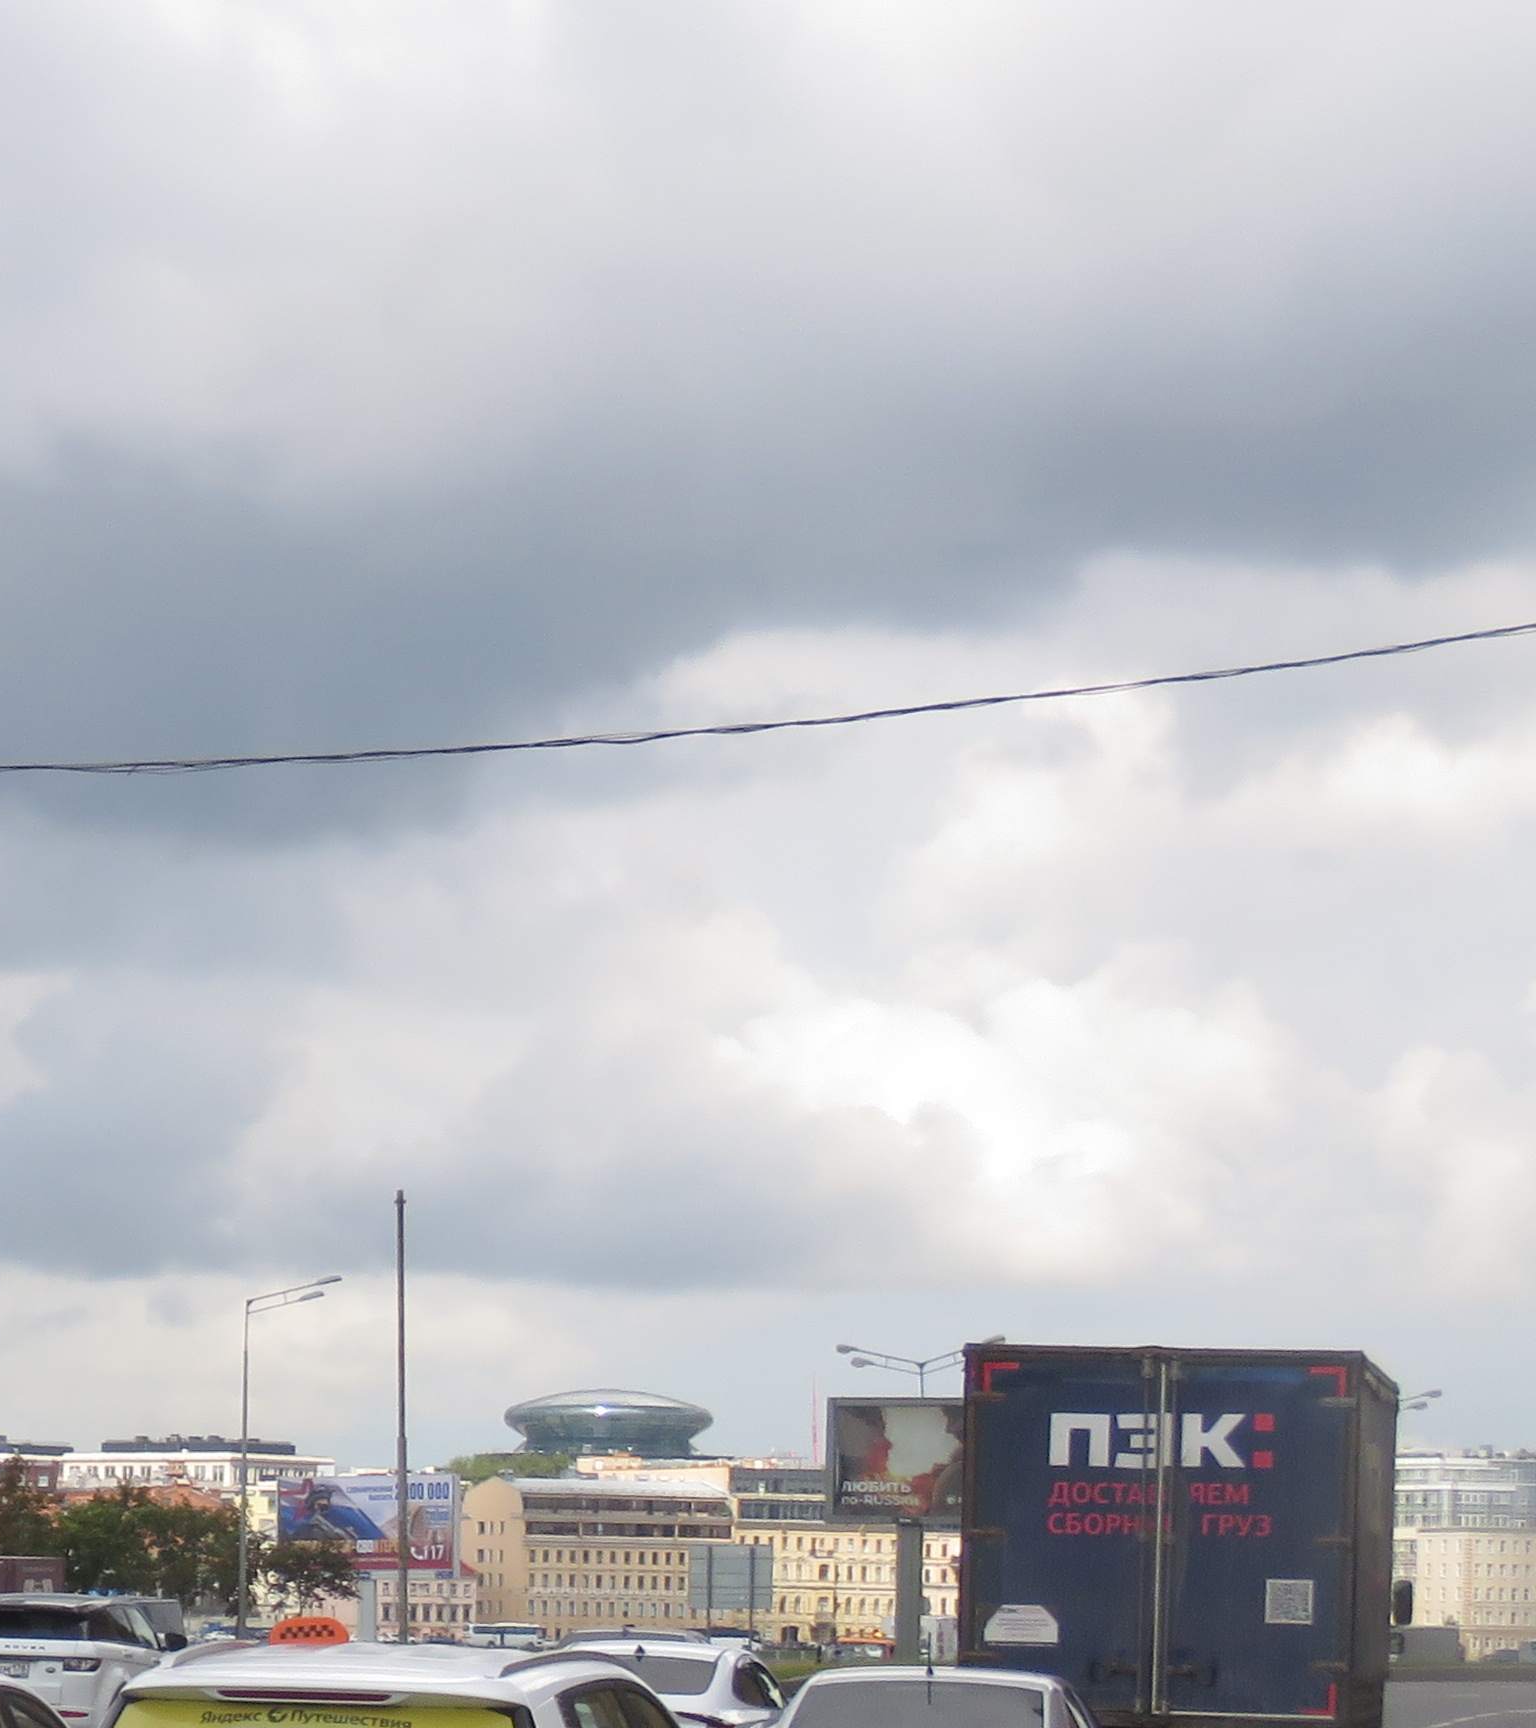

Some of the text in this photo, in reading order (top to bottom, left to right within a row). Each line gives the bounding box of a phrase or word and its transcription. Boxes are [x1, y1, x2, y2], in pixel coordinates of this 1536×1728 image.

[841, 1480, 912, 1493] ЛЮБИТЬ
[1047, 1482, 1250, 1506] ДОСТАВЯЕМ
[1201, 1513, 1274, 1537] ГРУЗ
[199, 1710, 263, 1725] Яндекс
